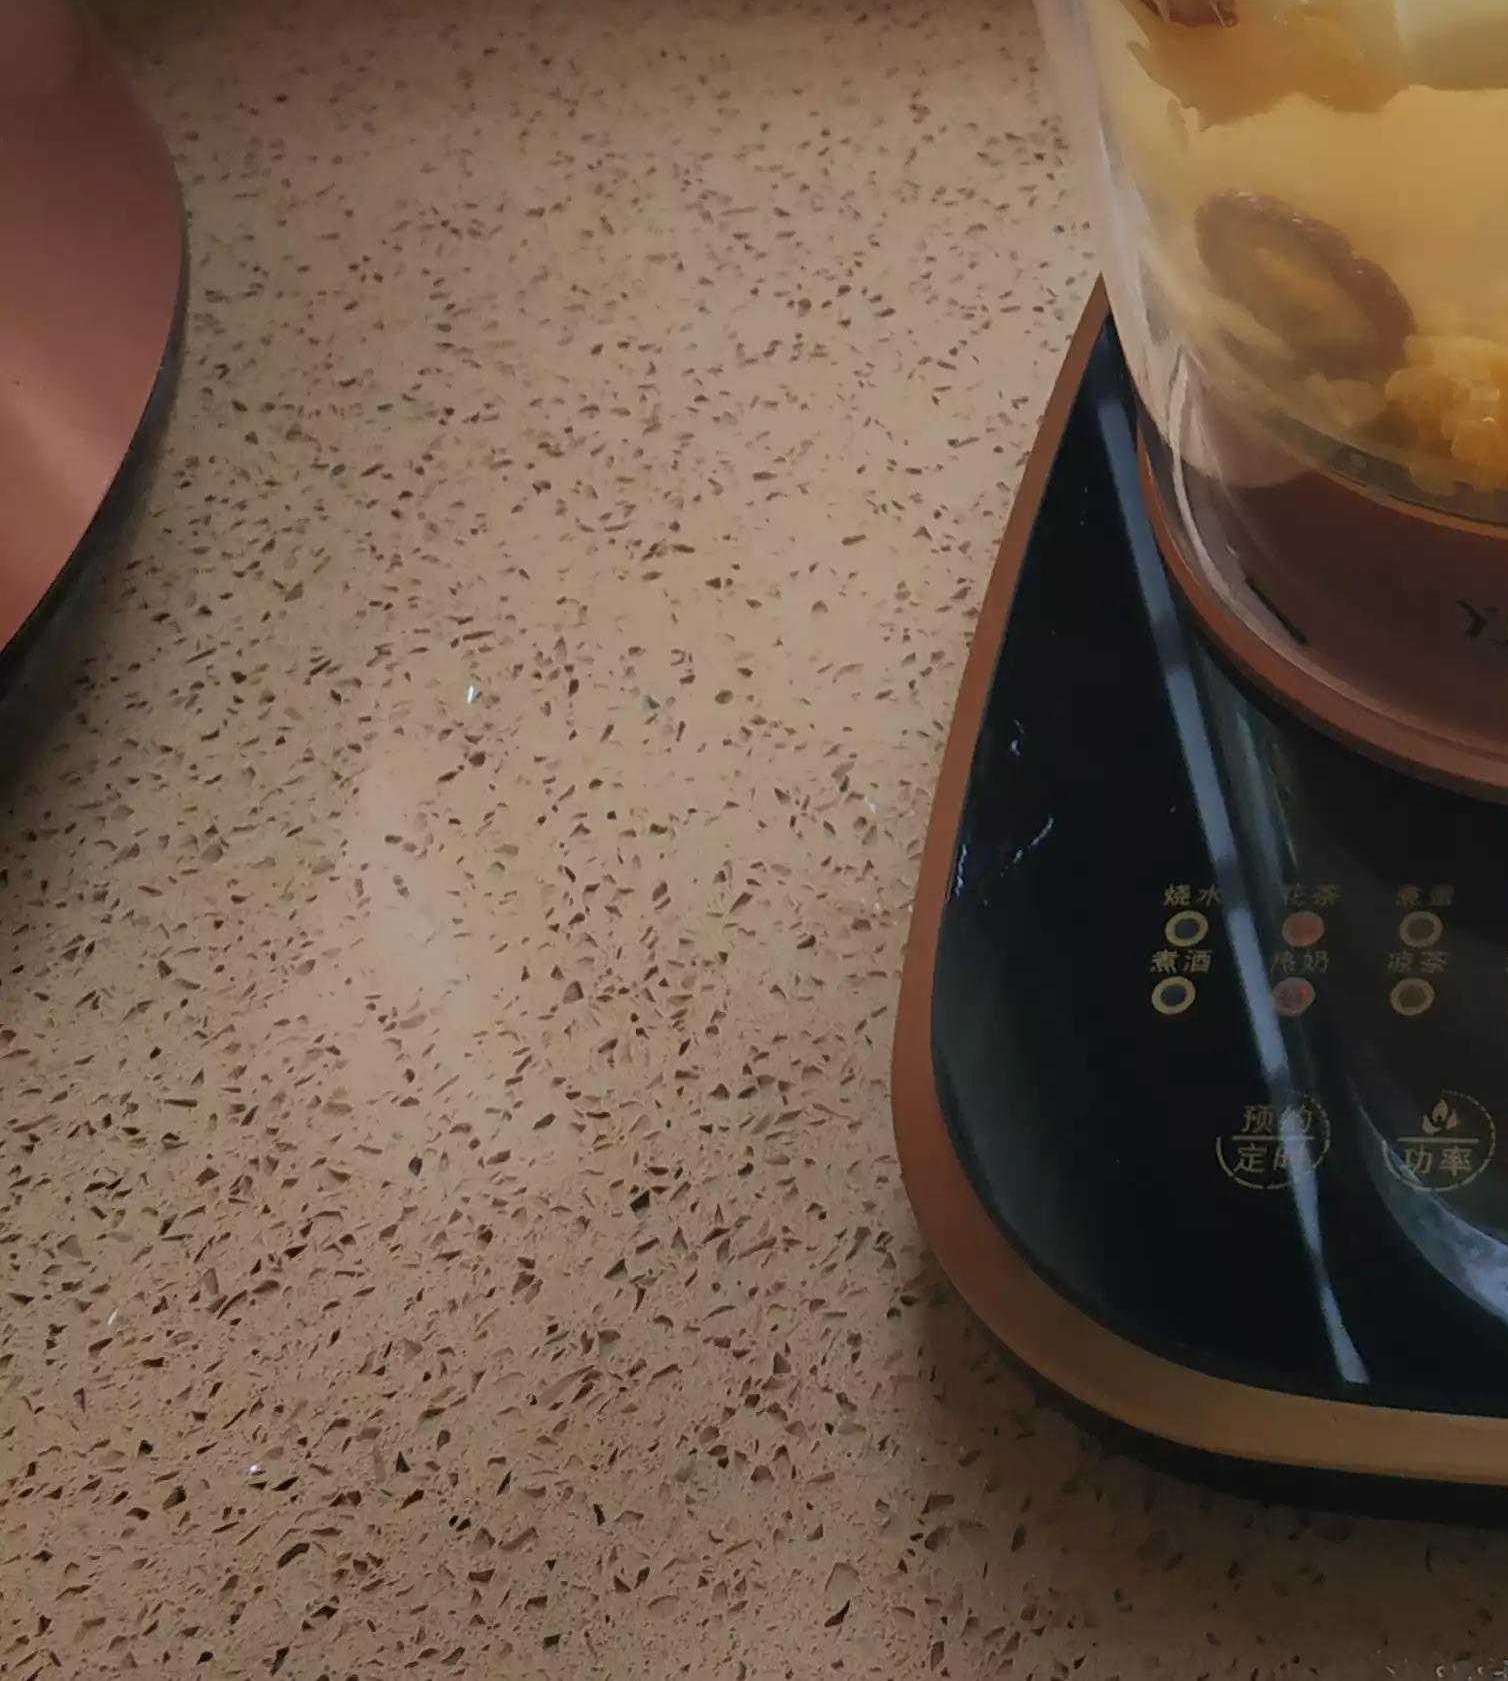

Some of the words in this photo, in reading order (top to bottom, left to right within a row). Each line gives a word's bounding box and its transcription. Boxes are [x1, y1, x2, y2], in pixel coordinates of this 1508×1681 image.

[1164, 884, 1221, 907] 烧水
[1152, 949, 1213, 974] 煮酒
[1405, 1143, 1473, 1177] 功率
